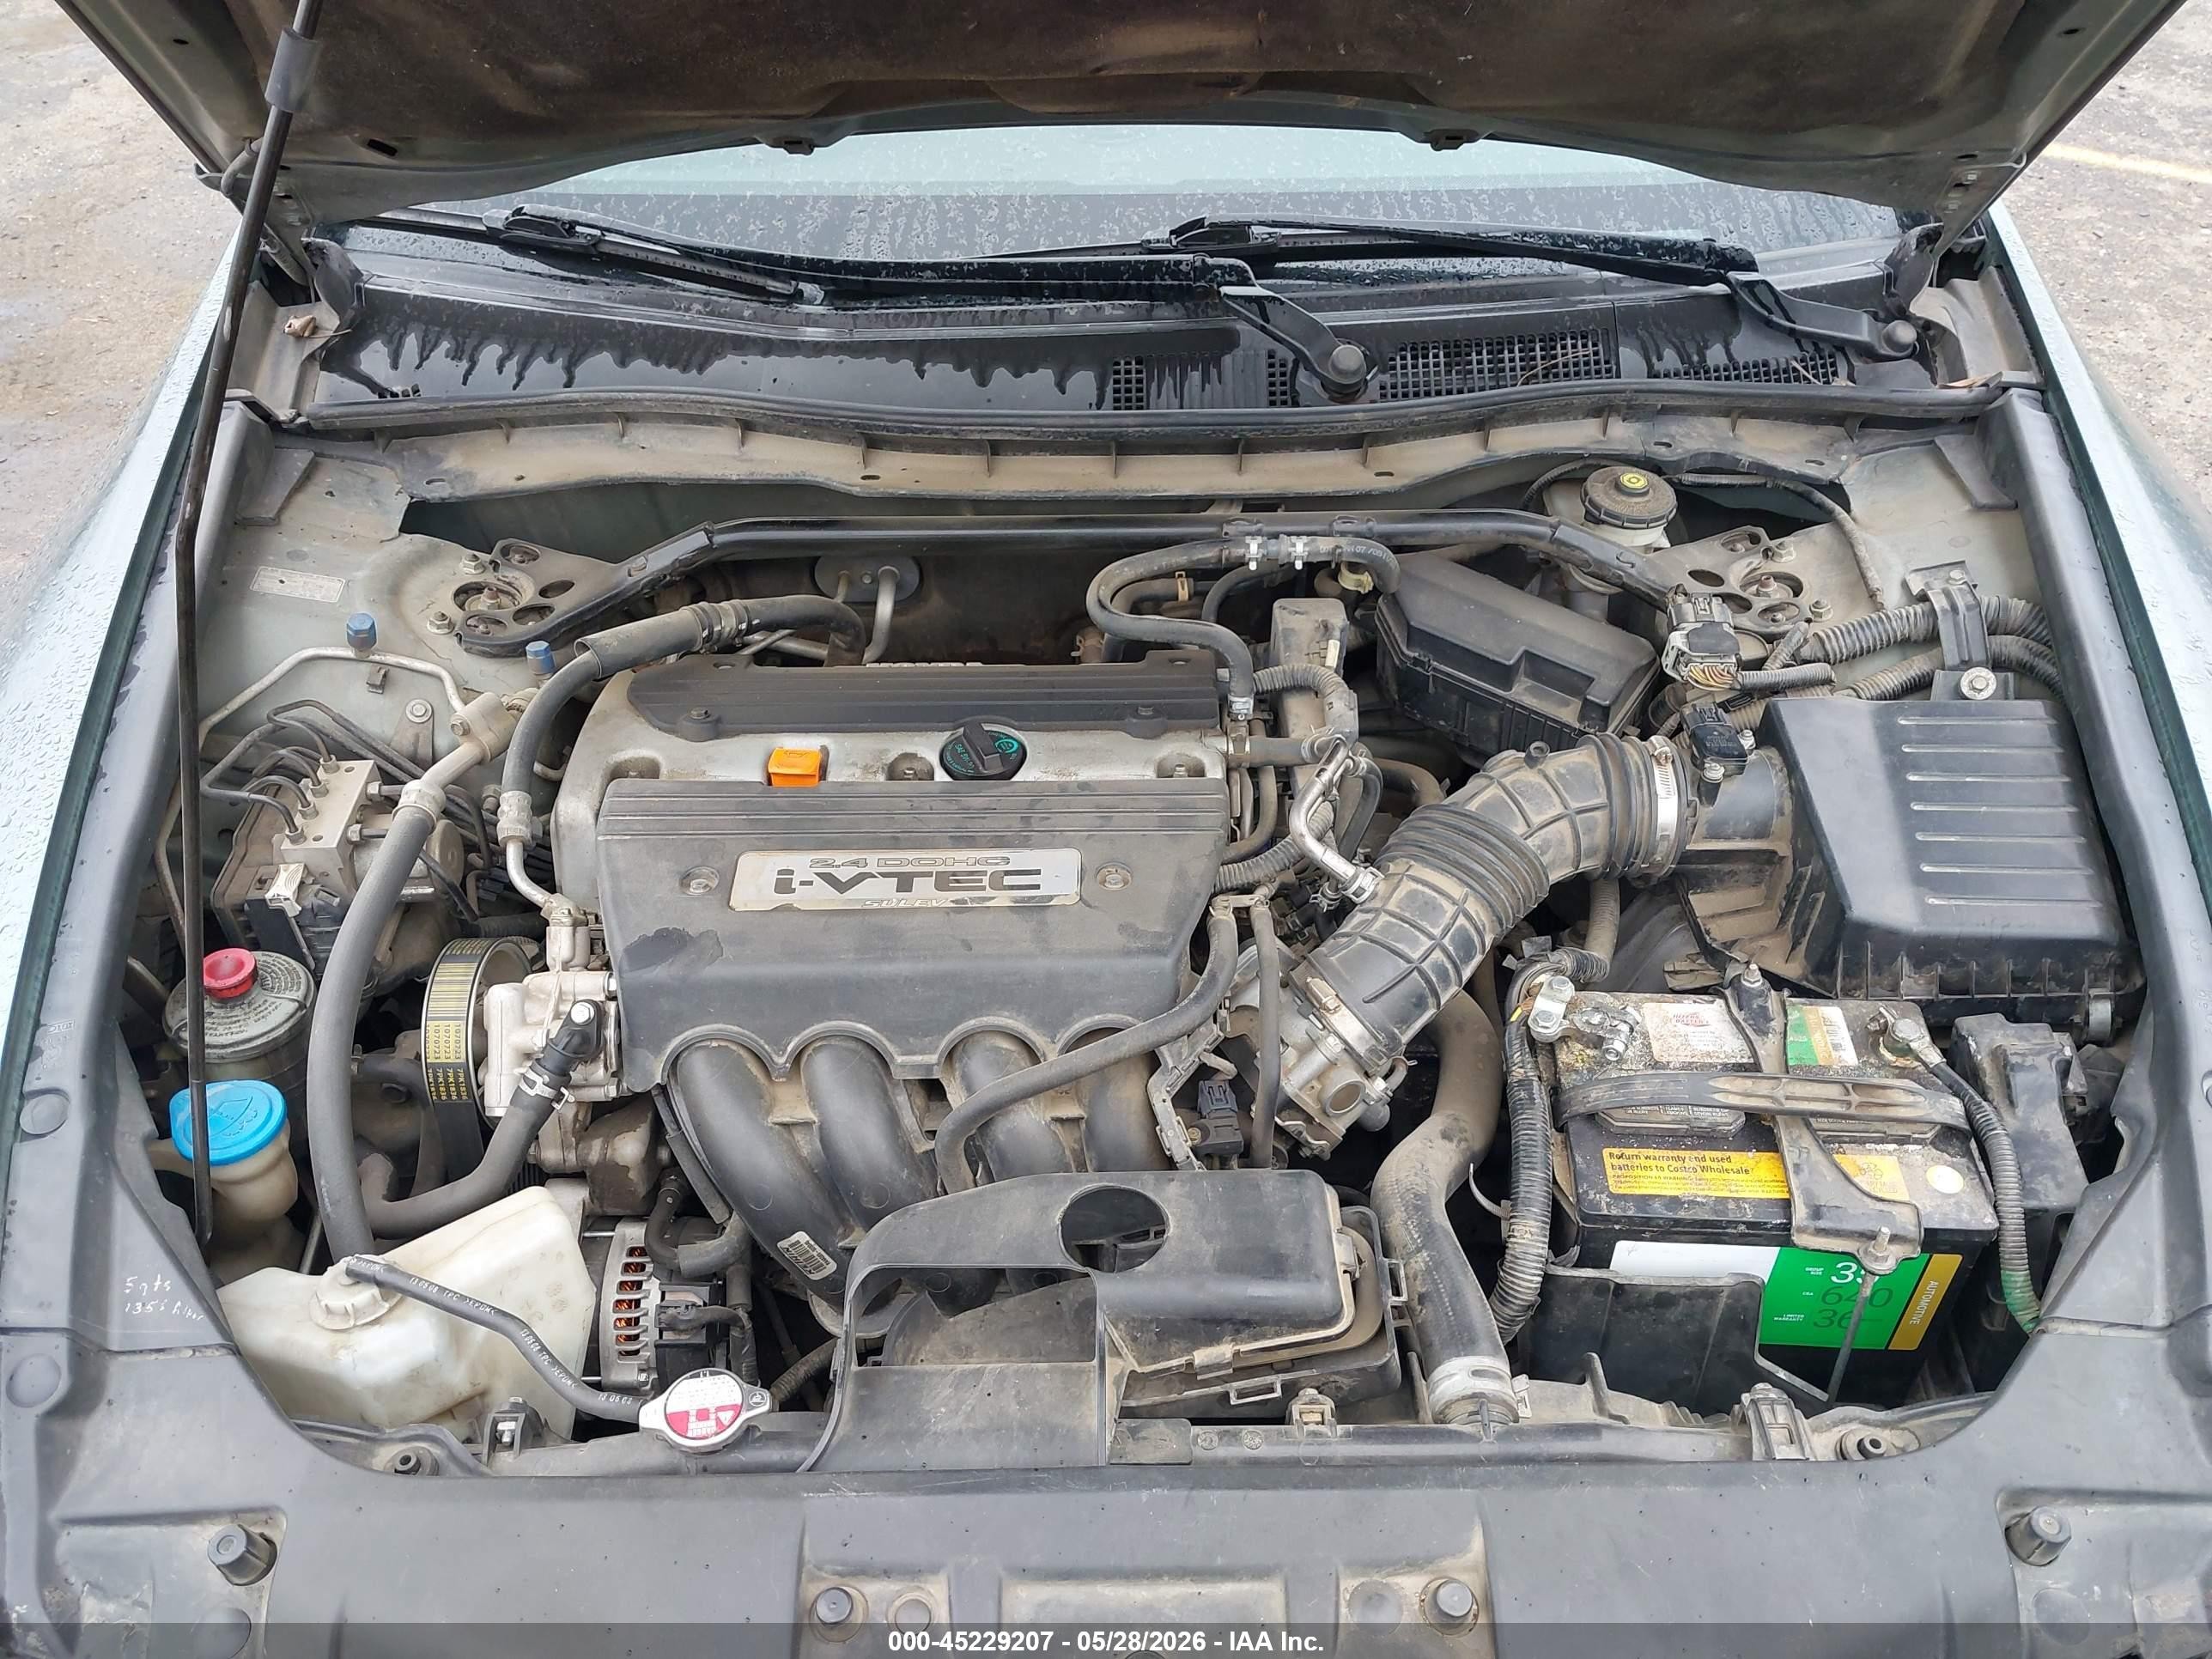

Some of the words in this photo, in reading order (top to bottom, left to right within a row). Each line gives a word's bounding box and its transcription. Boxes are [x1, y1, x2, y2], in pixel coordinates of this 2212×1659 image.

[809, 858, 868, 868] 2.4
[877, 856, 1011, 867] DOHC
[774, 869, 1042, 895] i-VTEC
[436, 1068, 447, 1101] 7PK1836
[447, 1068, 457, 1100] 7PK1836
[457, 1068, 468, 1100] 7PK1836
[1611, 1163, 1653, 1171] batteries
[1668, 1164, 1698, 1174] Costco
[1699, 1165, 1750, 1176] Wholesale
[1644, 1153, 1686, 1164] warranty
[1909, 1280, 1939, 1325] AUTOMOTIVE
